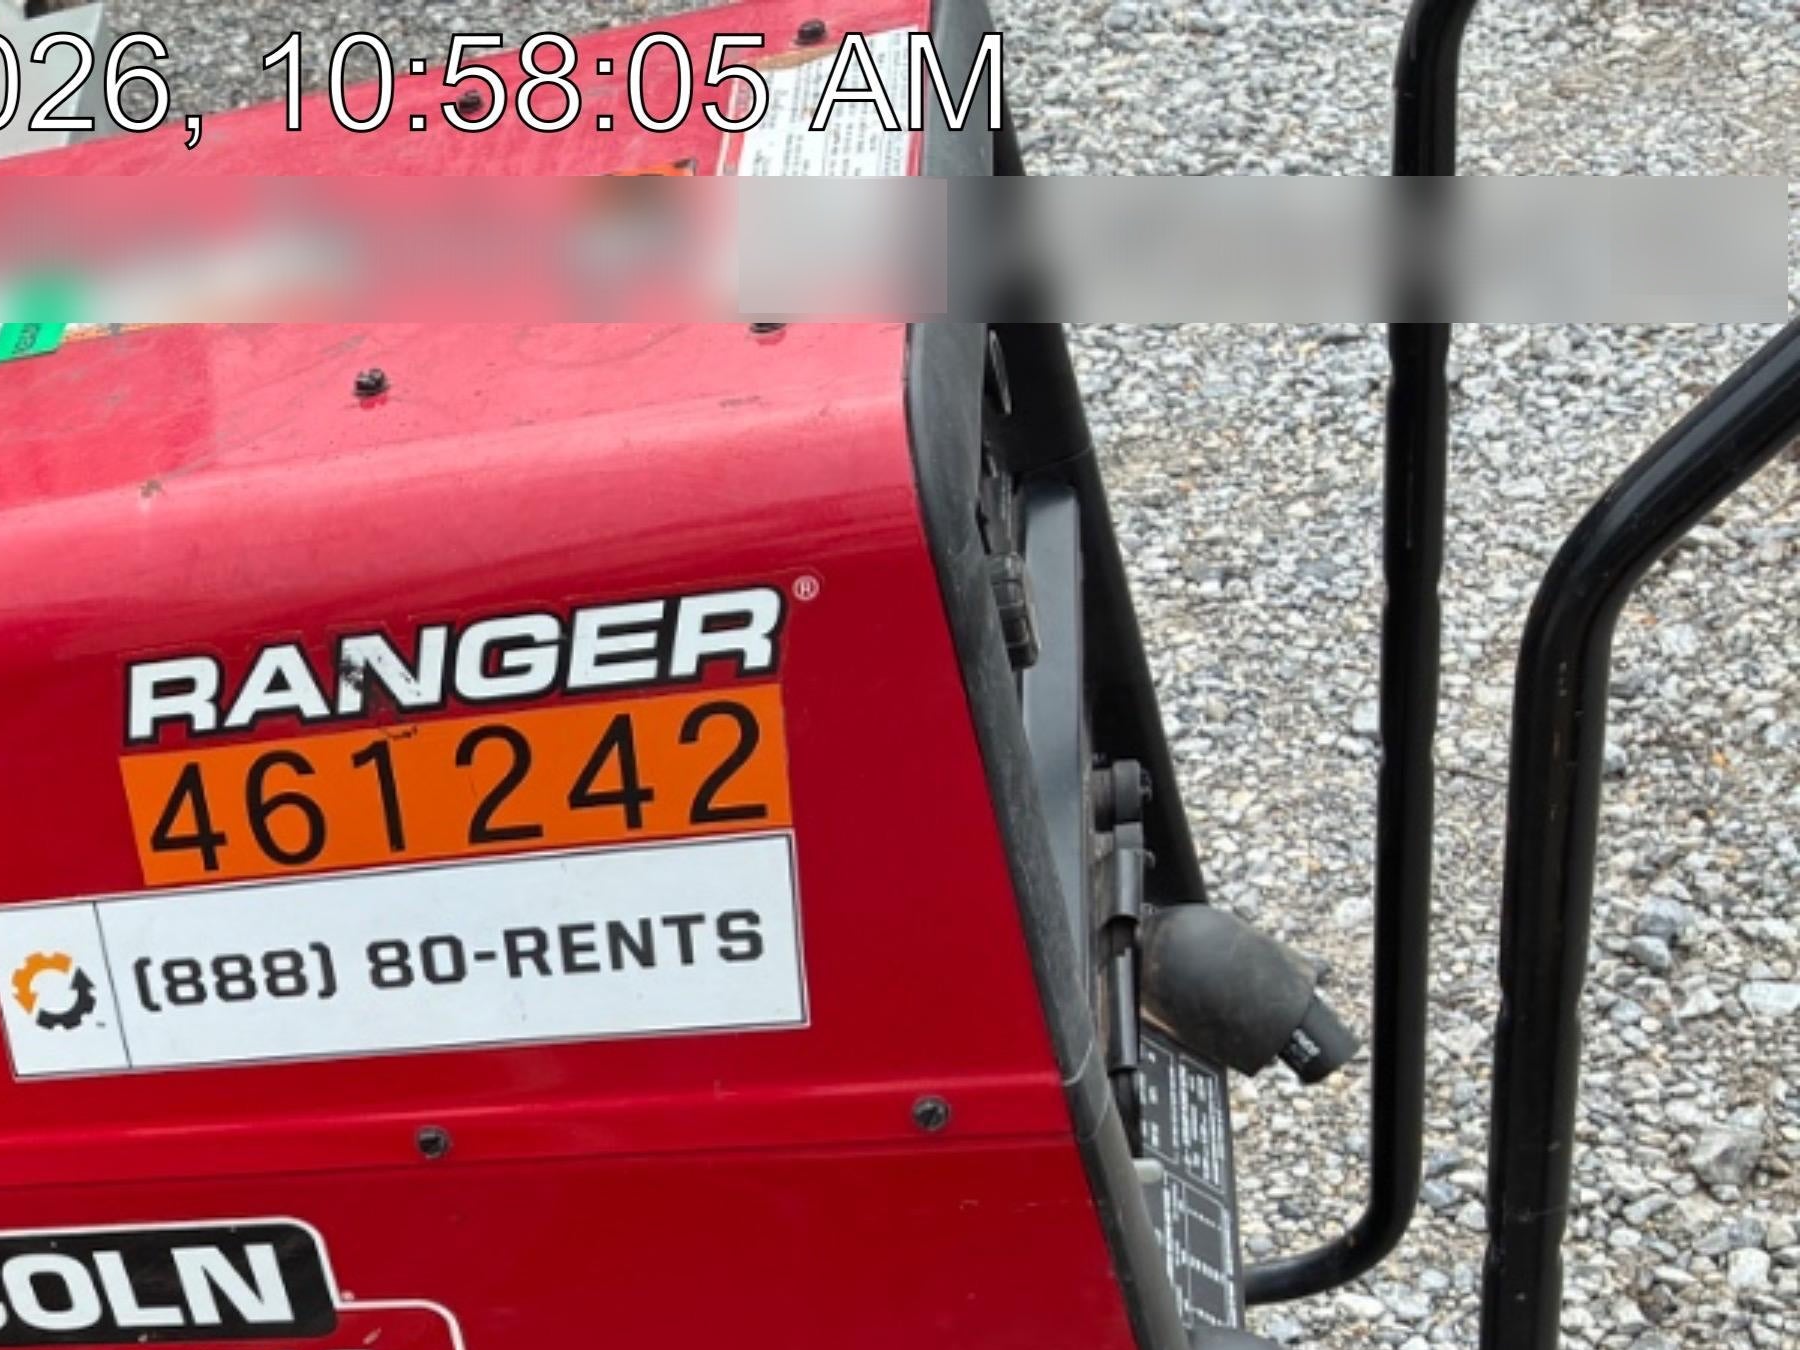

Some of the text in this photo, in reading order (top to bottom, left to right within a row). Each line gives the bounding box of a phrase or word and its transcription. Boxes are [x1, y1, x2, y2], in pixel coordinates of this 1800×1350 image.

[128, 586, 782, 740] RANGER
[149, 698, 770, 872] 461242
[132, 910, 764, 1013] (888) 80-RENTS
